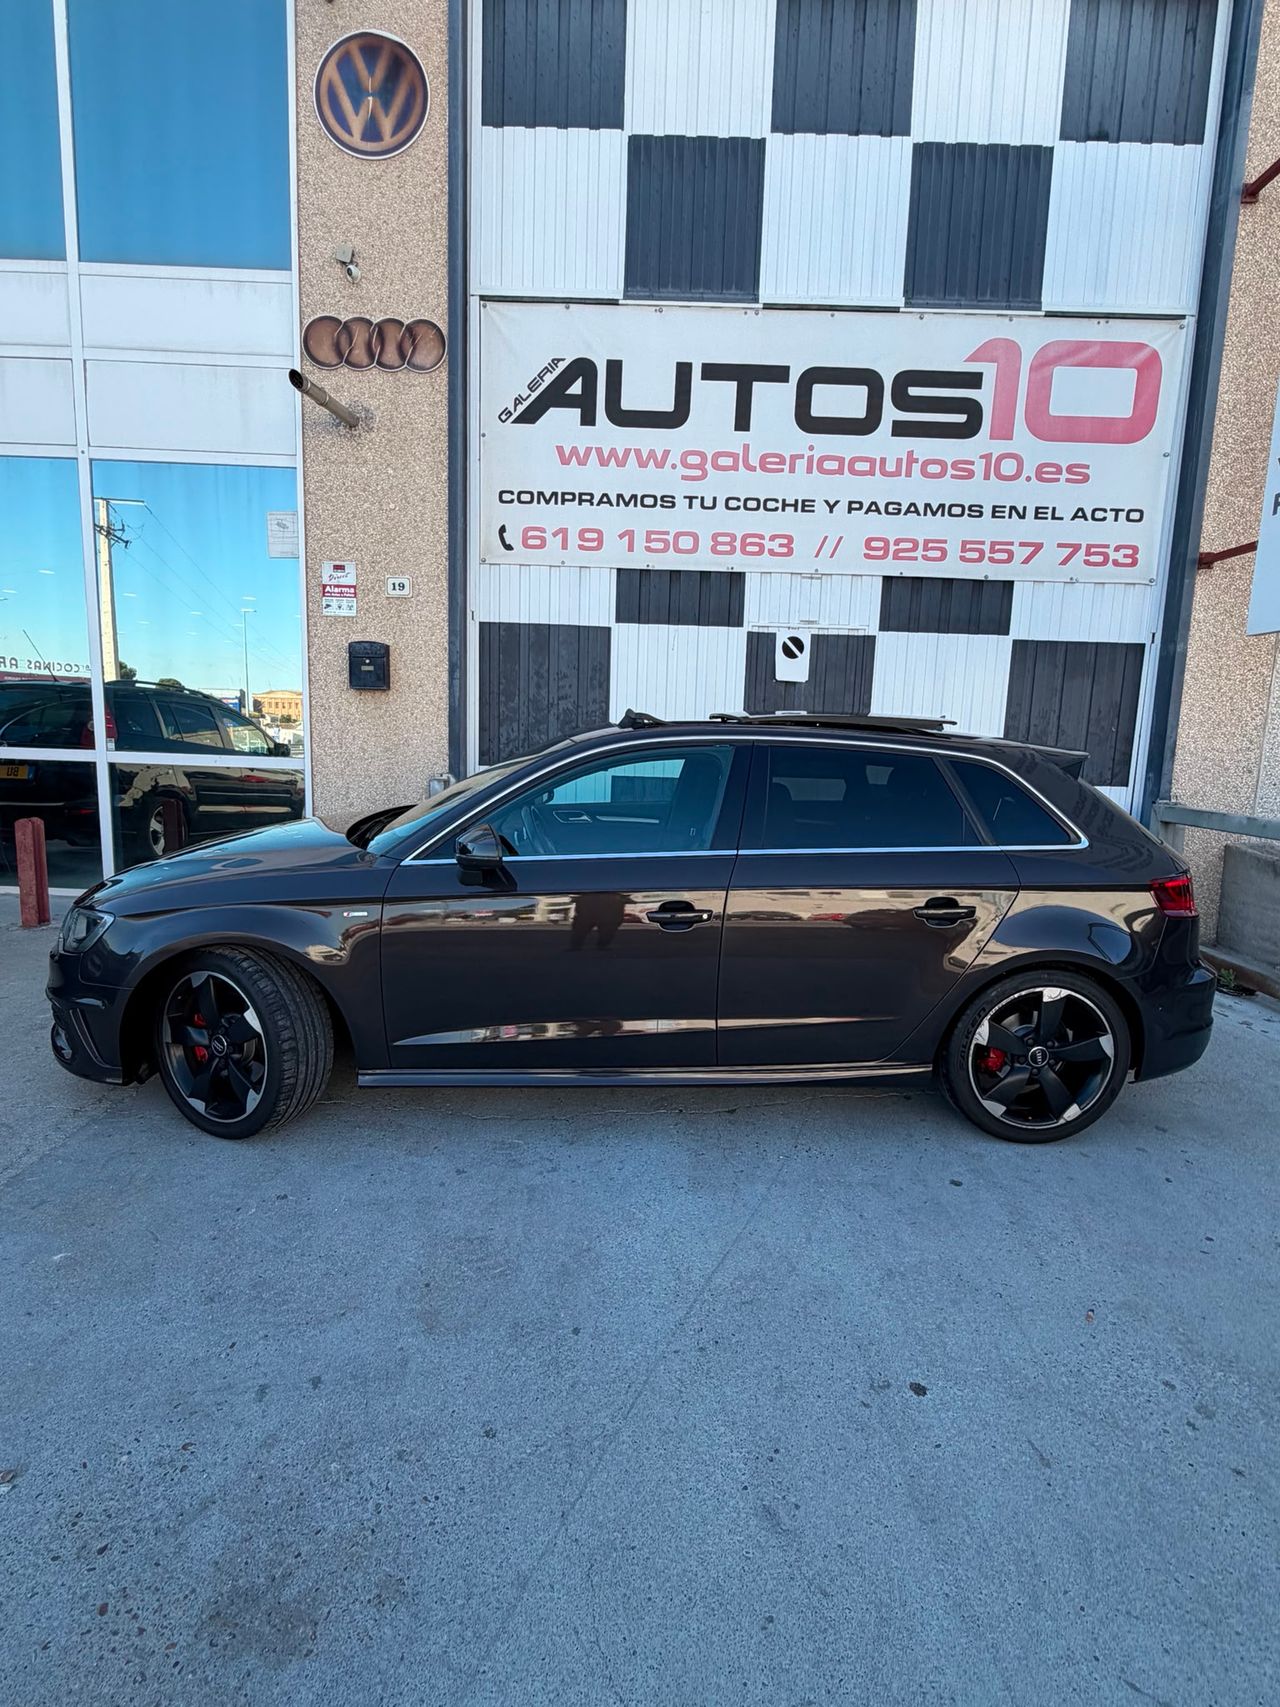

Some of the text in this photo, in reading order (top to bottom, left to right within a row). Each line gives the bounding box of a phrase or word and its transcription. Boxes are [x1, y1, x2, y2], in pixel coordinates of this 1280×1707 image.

[498, 357, 567, 424] GALERIA
[555, 443, 1091, 485] www.galeriaautos10.es
[498, 489, 1145, 523] COMPRAMOS TU COCHE Y PAGAMOS EN EL ACTO
[520, 525, 604, 552] 619
[617, 529, 700, 555] 150
[710, 531, 795, 558] 863
[863, 536, 948, 563] 925
[959, 539, 1044, 566] 557
[1056, 542, 1140, 569] 753
[324, 585, 355, 594] Alarma
[391, 582, 406, 592] 19
